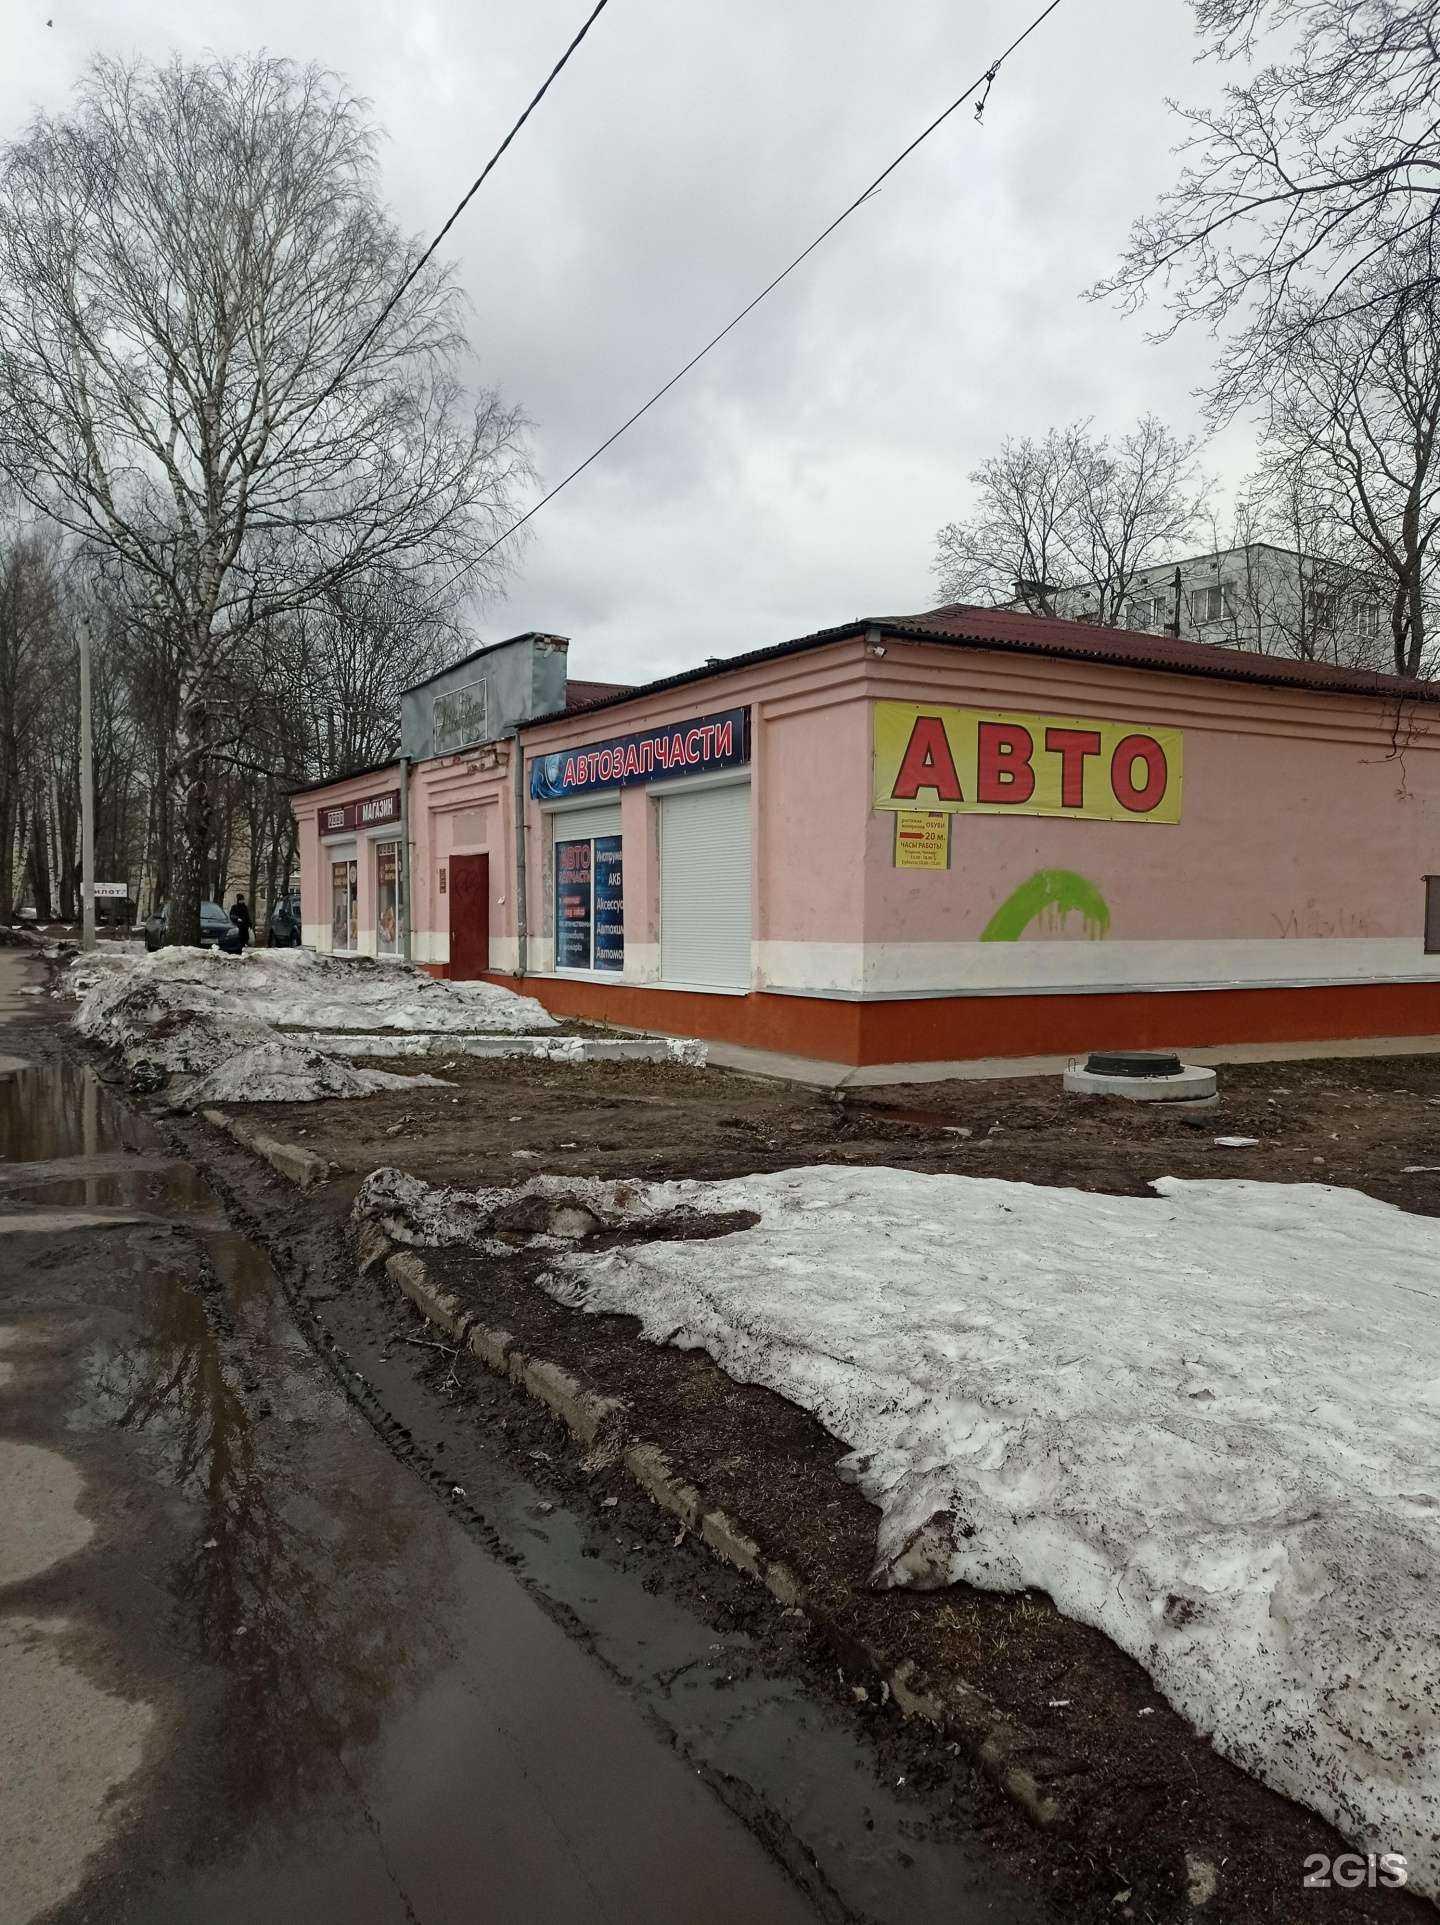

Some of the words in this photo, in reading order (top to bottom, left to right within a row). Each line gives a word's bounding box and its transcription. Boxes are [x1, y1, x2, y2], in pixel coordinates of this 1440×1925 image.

[562, 720, 734, 787] АВТОЗАПЧАСТИ
[890, 715, 1168, 813] АВТО
[362, 797, 393, 822] МАГАЗИН
[925, 831, 936, 841] 20
[608, 872, 621, 887] АКБ
